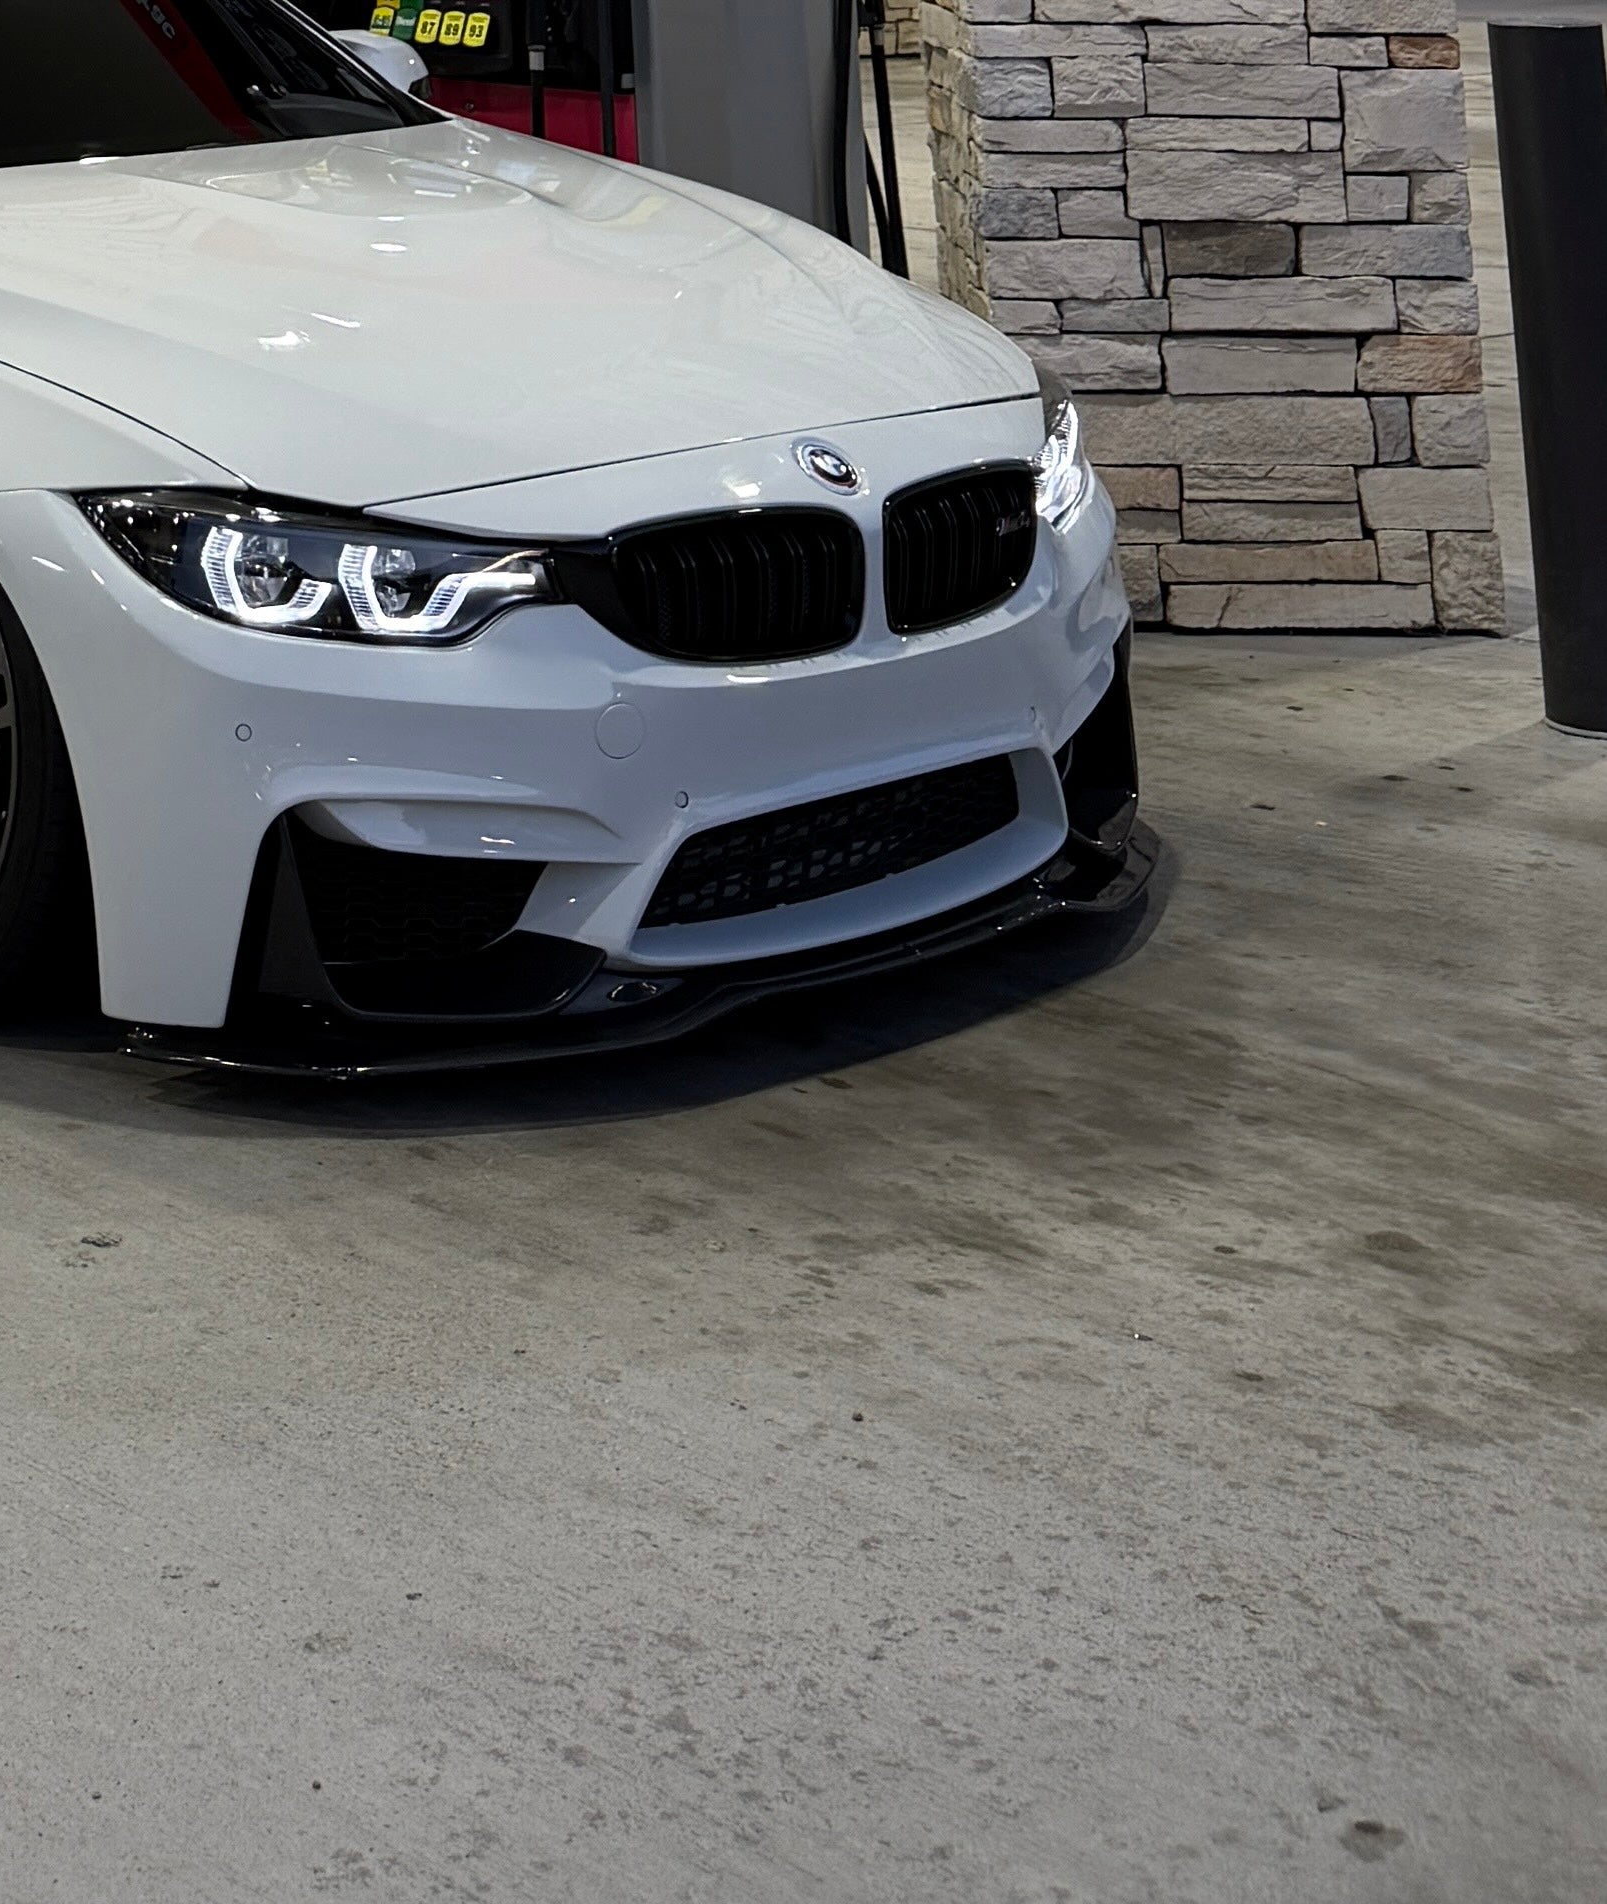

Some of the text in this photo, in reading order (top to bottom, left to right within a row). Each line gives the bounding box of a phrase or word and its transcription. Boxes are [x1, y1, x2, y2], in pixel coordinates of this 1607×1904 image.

[421, 20, 436, 34] 87
[444, 23, 460, 36] 89
[468, 24, 484, 38] 93
